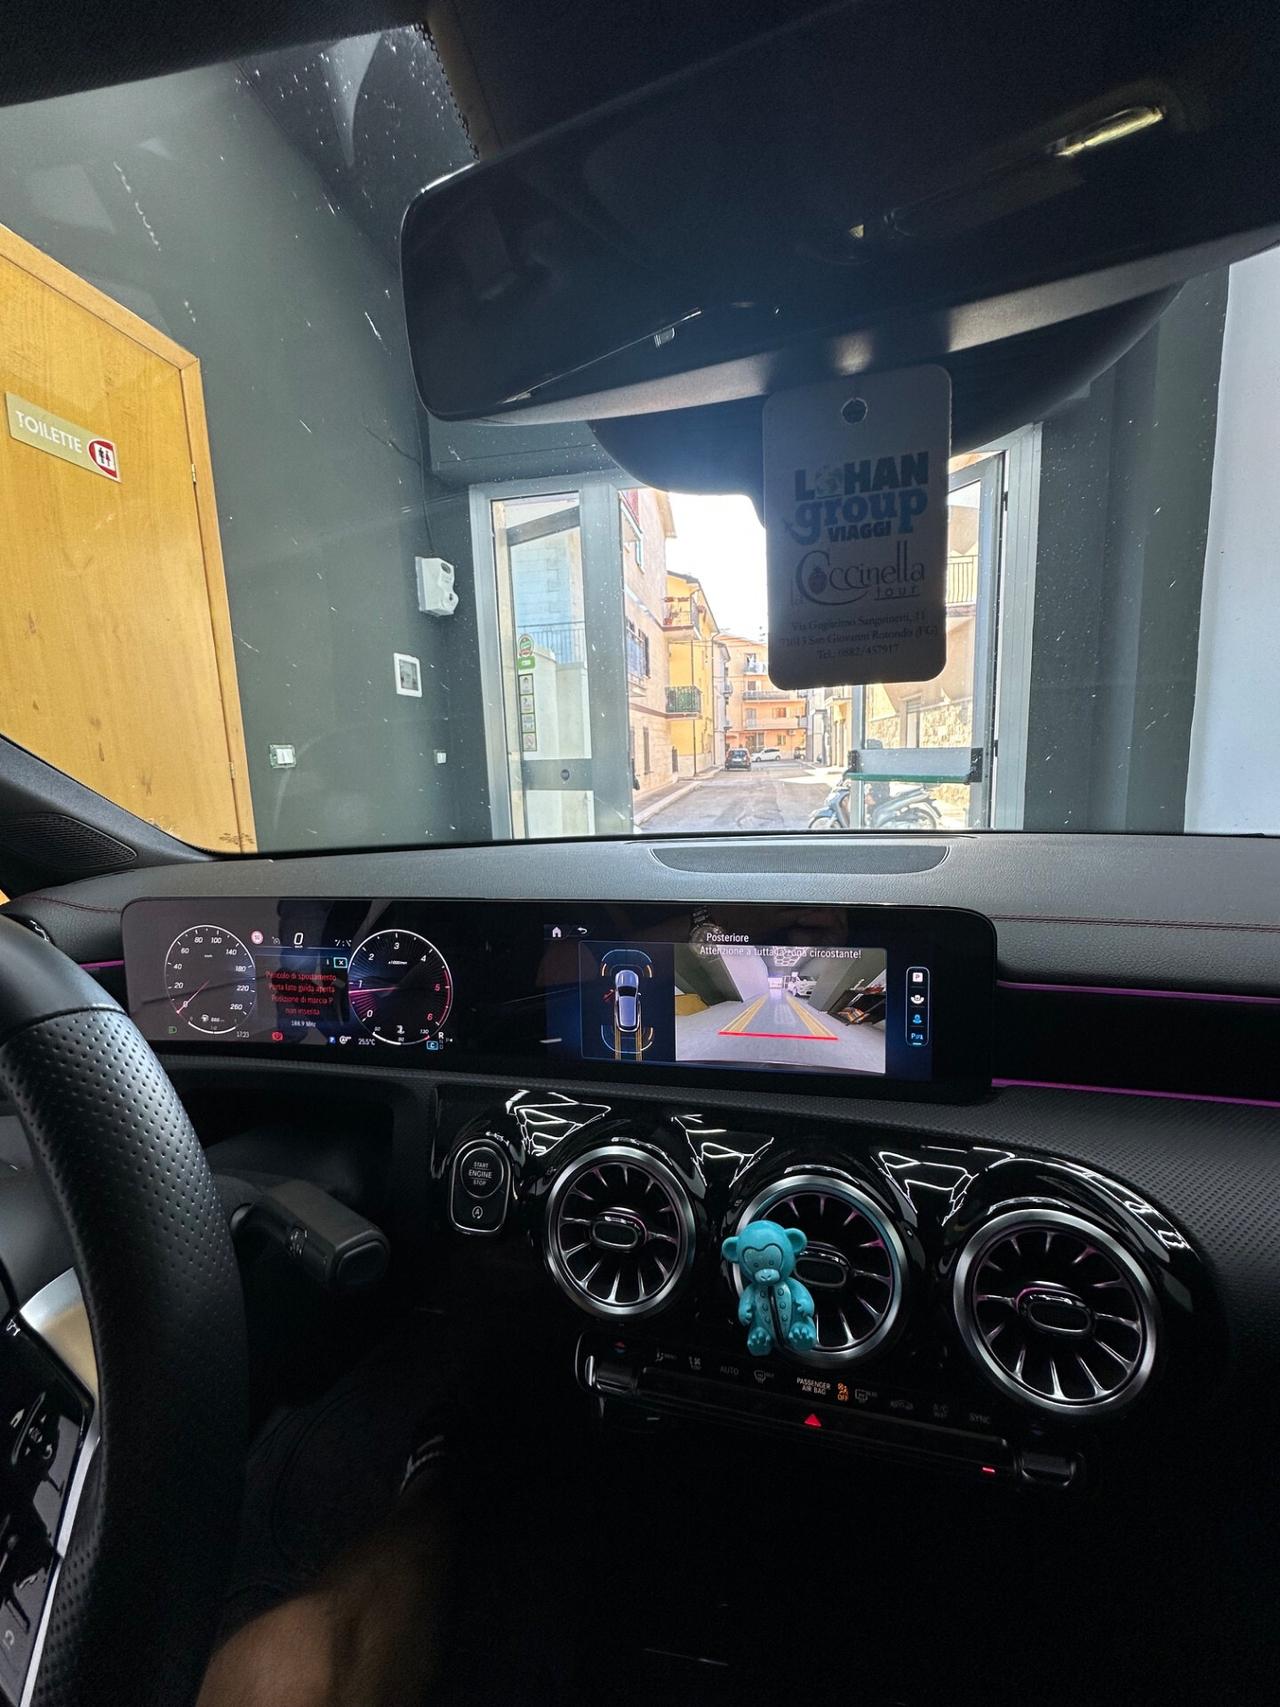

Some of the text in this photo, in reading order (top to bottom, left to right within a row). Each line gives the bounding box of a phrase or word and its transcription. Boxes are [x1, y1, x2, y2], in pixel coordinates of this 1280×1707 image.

[16, 410, 83, 454] TOILETTE
[785, 488, 928, 546] group
[828, 520, 892, 544] VIAGGI
[875, 583, 921, 601] tour
[808, 635, 826, 646] San
[826, 629, 870, 644] Giovanni
[872, 627, 913, 641] Rotondo
[294, 932, 304, 945] 0
[706, 933, 749, 942] Posteriore
[700, 946, 744, 956] Attenzione
[809, 949, 862, 959] circostante!
[468, 1170, 492, 1178] ENGINE
[720, 1366, 740, 1375] AUTO
[796, 1377, 831, 1390] PASSENGER
[814, 1386, 826, 1395] BAG
[837, 1394, 849, 1402] OFF
[969, 1413, 991, 1425] SYNC
